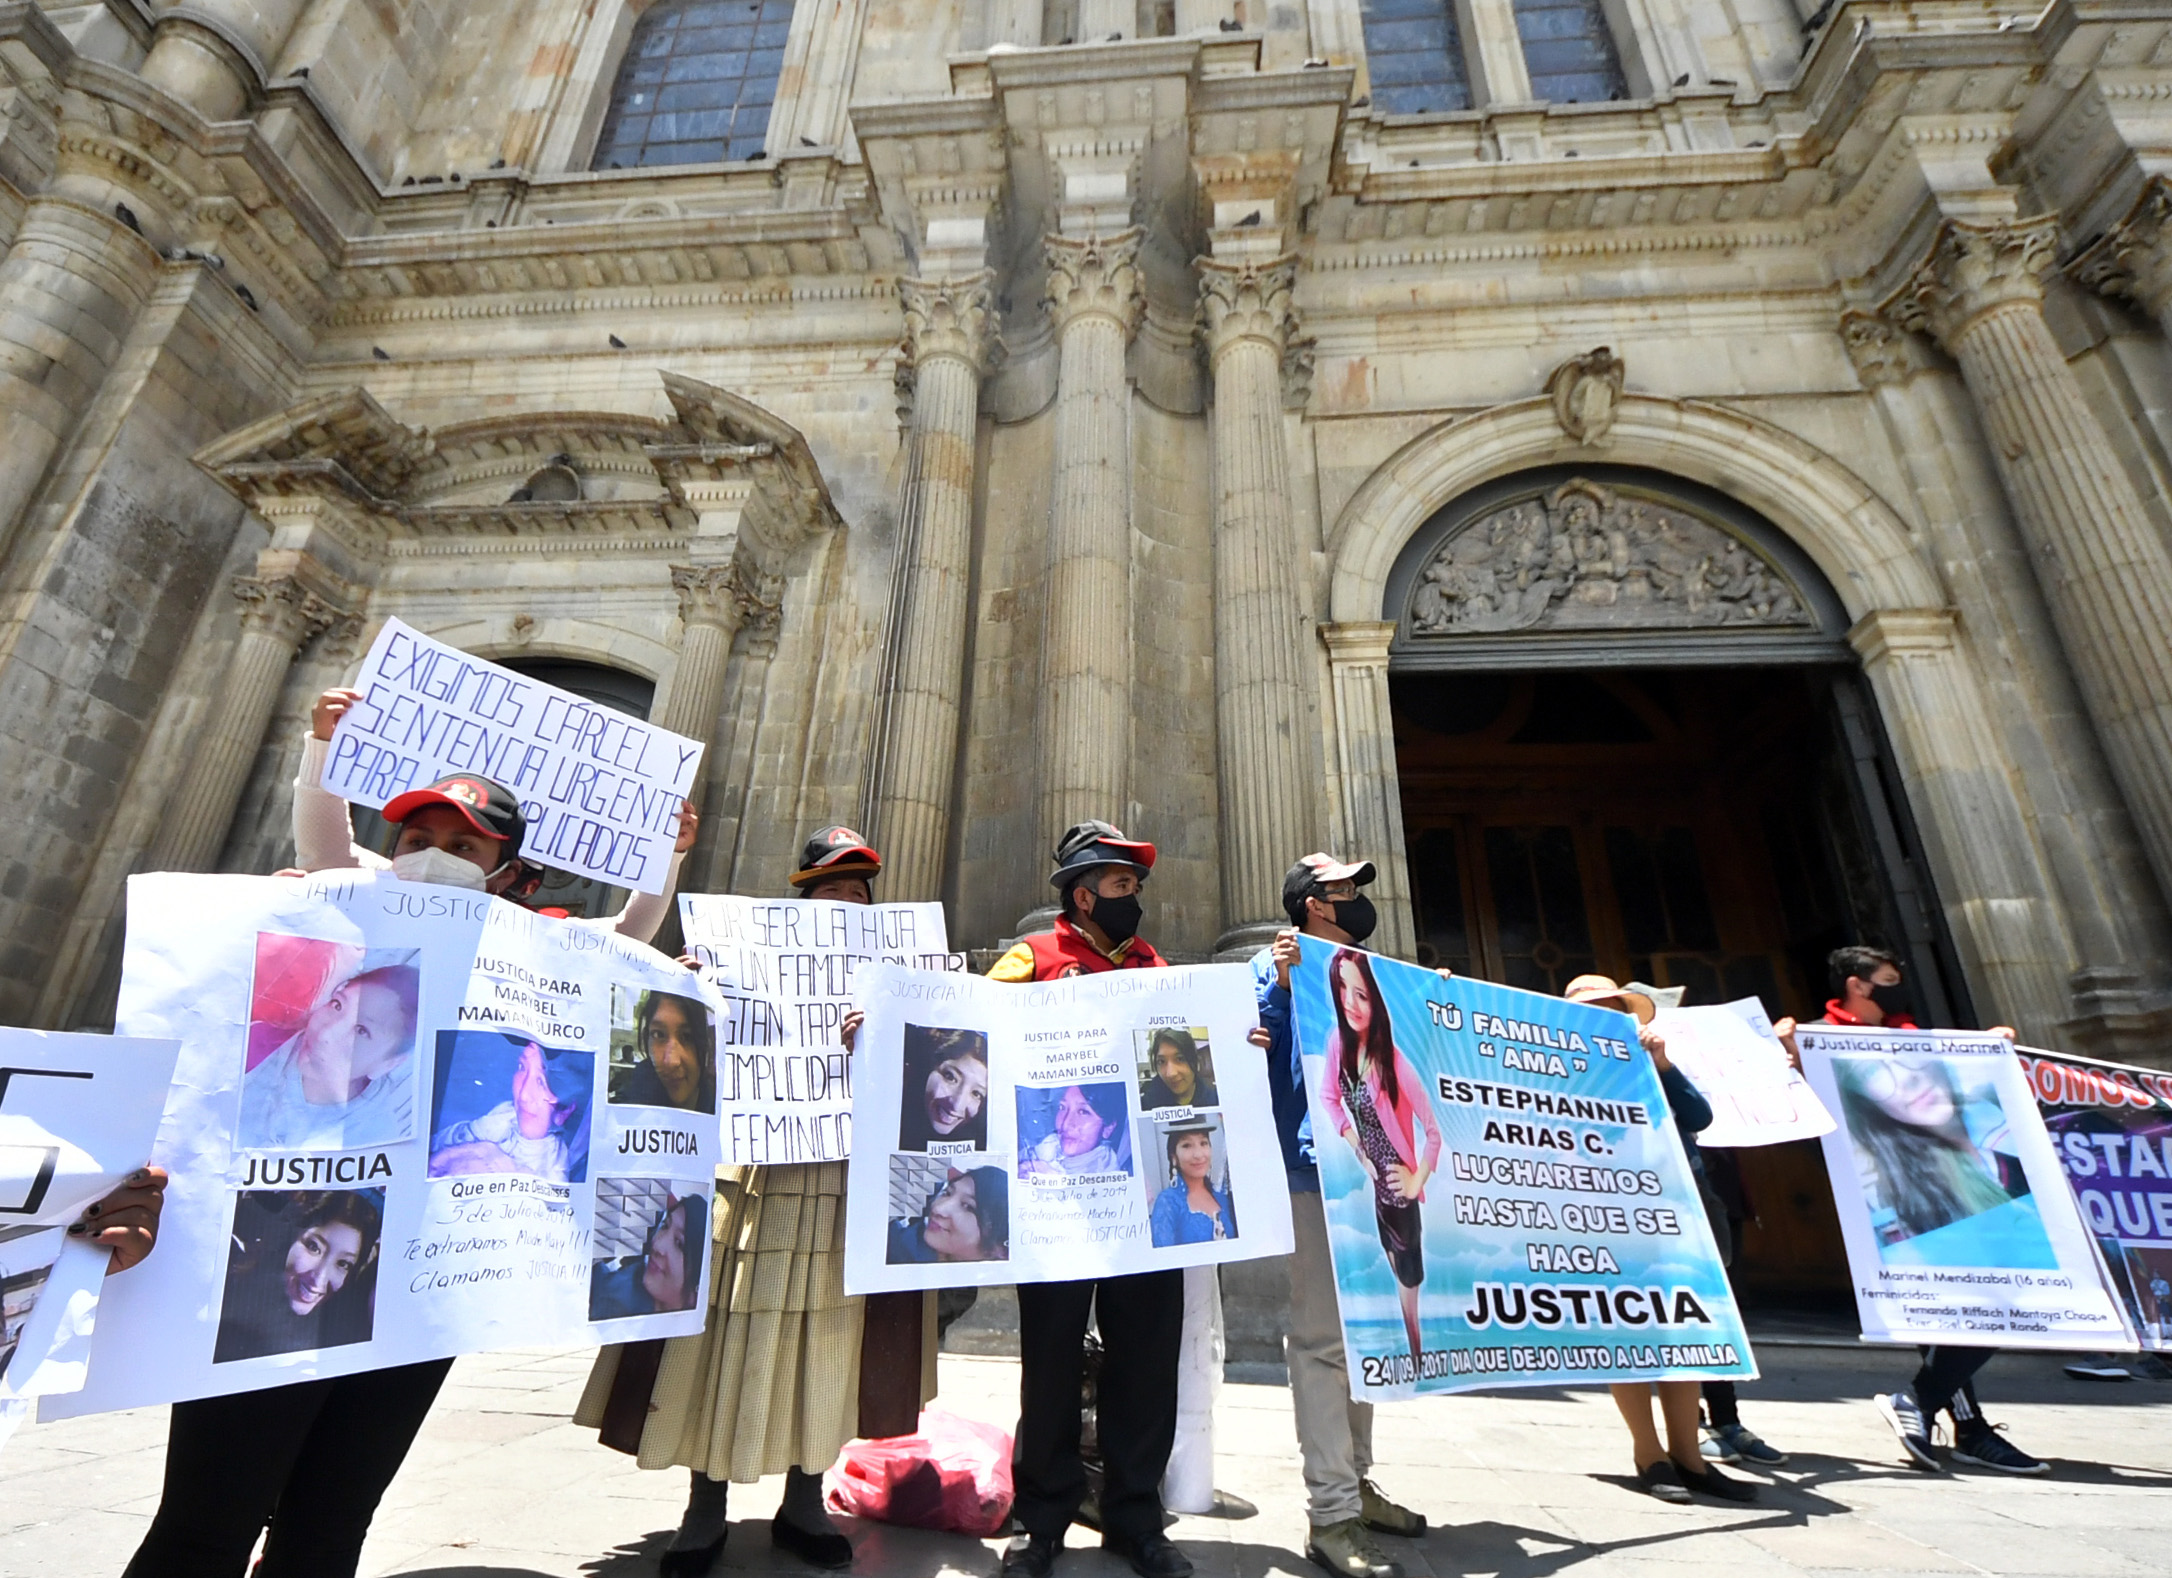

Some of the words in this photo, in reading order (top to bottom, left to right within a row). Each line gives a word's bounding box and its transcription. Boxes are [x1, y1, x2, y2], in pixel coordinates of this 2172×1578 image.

[377, 631, 532, 728] EXIGIMOS
[535, 696, 653, 778] CÁRCEL
[673, 744, 697, 785] Y
[328, 733, 420, 801] PARA
[350, 683, 549, 792] SENTENCIA
[548, 756, 687, 840] URGENTE
[520, 800, 653, 882] PLICADOS
[752, 906, 804, 948] SER
[813, 906, 848, 948] LA
[860, 909, 916, 950] HIJA
[474, 956, 536, 988] JUSTICIA
[539, 979, 583, 997] PARA
[694, 943, 735, 988] DE
[739, 947, 769, 994] UN
[778, 953, 872, 997] FAMOS
[494, 984, 558, 1017] MARYBEL
[458, 1005, 535, 1030] MAMANI
[536, 1020, 586, 1040] SURCO
[1024, 1030, 1071, 1043] JUSTICIA
[1077, 1027, 1108, 1039] PARA
[1148, 1016, 1187, 1026] JUSTICIA
[1426, 1000, 1463, 1031] TÚ
[1471, 1011, 1590, 1055] FAMILIA
[1591, 1035, 1631, 1062] TE
[1027, 1066, 1078, 1081] MAMANI
[1080, 1063, 1120, 1077] SURCO
[1045, 1049, 1099, 1064] MARYBEL
[1154, 1107, 1193, 1121] JUSTICIA
[1438, 1076, 1649, 1126] ESTEPHANNIE
[618, 1128, 699, 1156] JUSTICIA
[928, 1143, 973, 1156] JUSTICIA
[1483, 1121, 1575, 1152] ARIAS
[1584, 1132, 1614, 1156] C.
[242, 1152, 393, 1187] JUSTICIA
[1030, 1175, 1046, 1187] Que
[1048, 1179, 1058, 1187] en
[1060, 1176, 1077, 1187] Paz
[1078, 1173, 1128, 1186] Descanses
[1453, 1153, 1663, 1196] LUCHAREMOS
[451, 1182, 485, 1198] Que
[488, 1181, 506, 1194] en
[509, 1178, 530, 1193] Paz
[1086, 1187, 1099, 1200] de
[435, 1204, 466, 1225] 5
[466, 1203, 494, 1224] de
[498, 1200, 531, 1219] Julio
[1454, 1194, 1558, 1231] HASTA
[1561, 1203, 1630, 1234] QUE
[1633, 1206, 1682, 1236] SE
[2079, 1188, 2172, 1239] QUE
[403, 1238, 422, 1261] Te
[1526, 1242, 1621, 1275] HAGA
[409, 1266, 513, 1294] Clamamos
[1933, 1271, 2012, 1286] Mendizabal
[2014, 1273, 2033, 1288] (16
[1465, 1287, 1712, 1326] JUSTICIA
[1903, 1304, 1958, 1316] Fernando
[1962, 1305, 2004, 1318] Riffach
[2009, 1308, 2061, 1323] Montoya
[2064, 1309, 2107, 1323] Choque
[1965, 1319, 2006, 1333] Quispe
[1450, 1348, 1473, 1374] DIA
[1473, 1346, 1509, 1374] QUE
[1511, 1346, 1561, 1372] DEJO
[1561, 1345, 1612, 1370] LUTO
[1614, 1345, 1632, 1368] A
[1631, 1345, 1660, 1368] LA
[1658, 1343, 1741, 1368] FAMILIA
